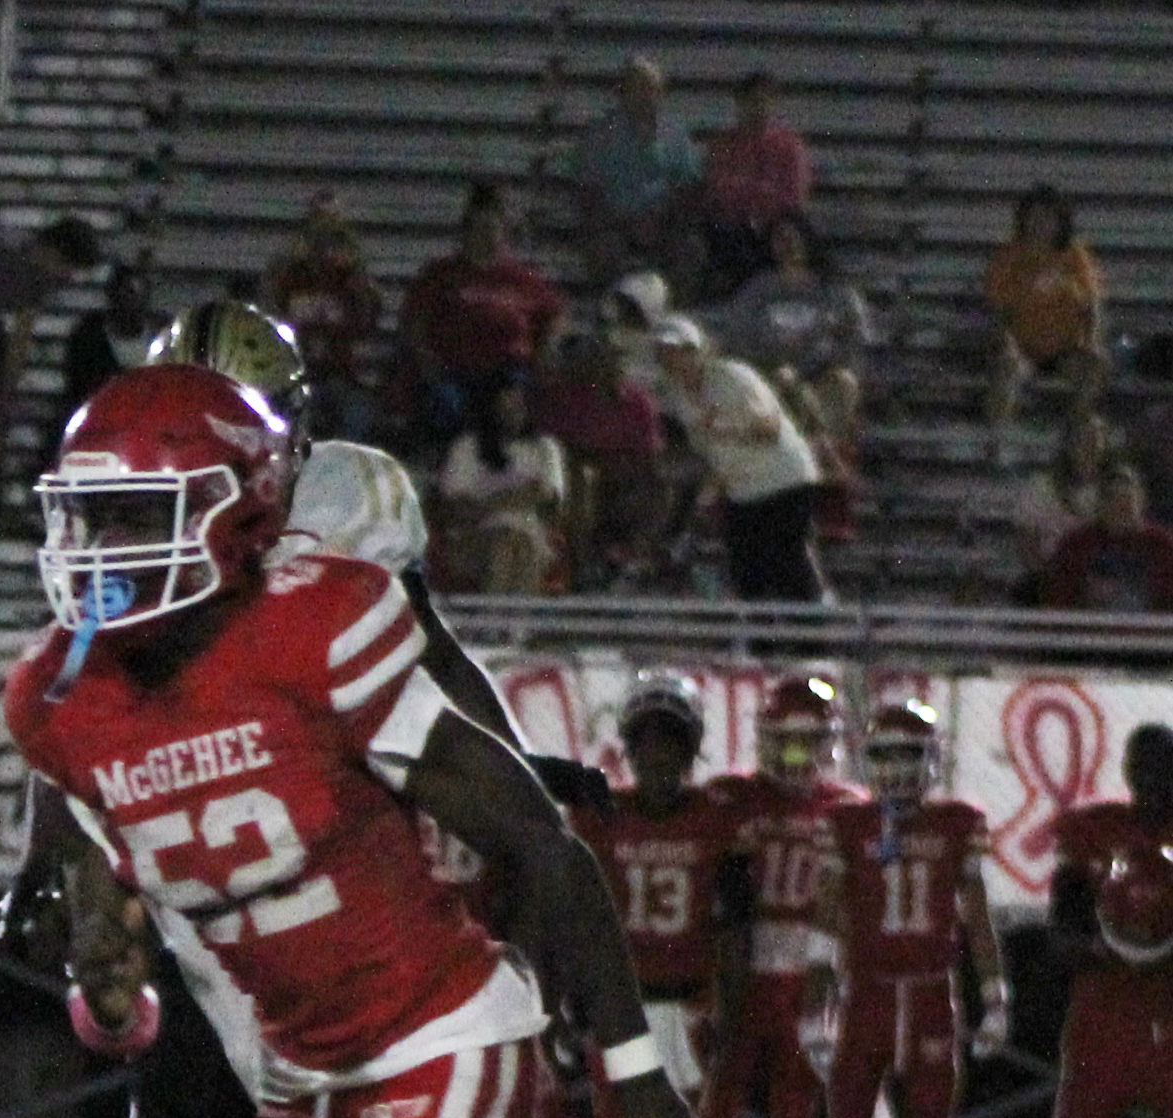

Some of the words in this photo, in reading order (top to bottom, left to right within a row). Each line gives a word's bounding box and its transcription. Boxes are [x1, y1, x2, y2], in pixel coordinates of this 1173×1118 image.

[92, 721, 273, 810] McGEHEE
[119, 787, 342, 944] 52
[627, 865, 691, 933] 13
[879, 863, 931, 932] 11
